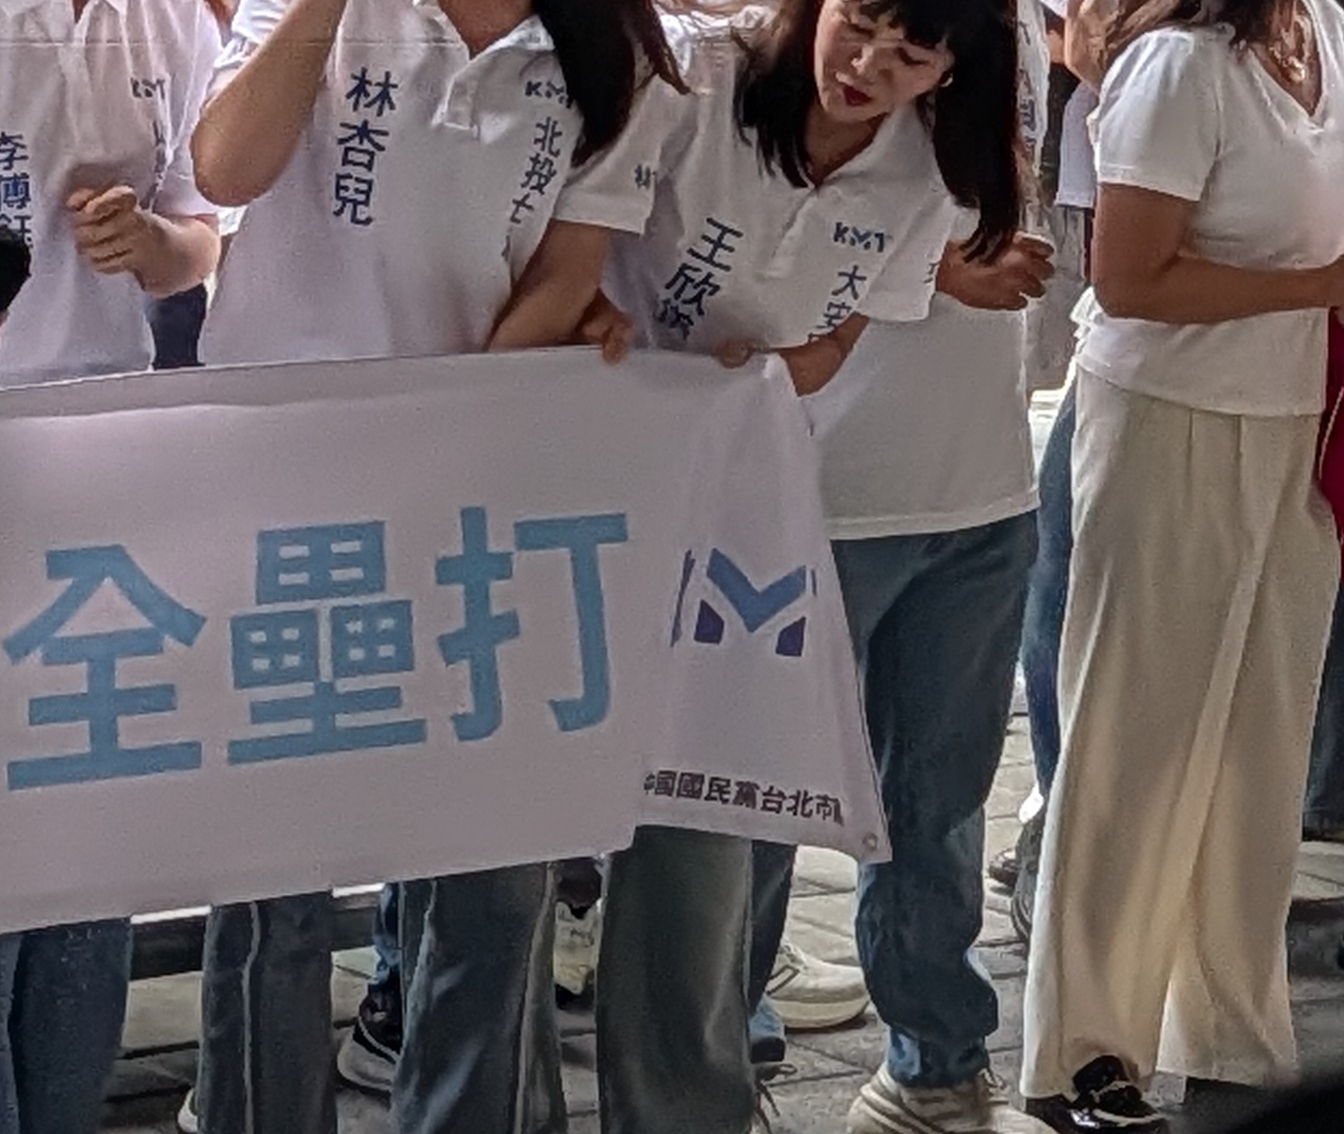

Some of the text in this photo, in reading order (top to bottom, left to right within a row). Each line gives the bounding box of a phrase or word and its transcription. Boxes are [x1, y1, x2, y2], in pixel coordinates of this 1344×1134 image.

[332, 66, 399, 227] 林杏兒
[1, 505, 629, 791] 全壘打
